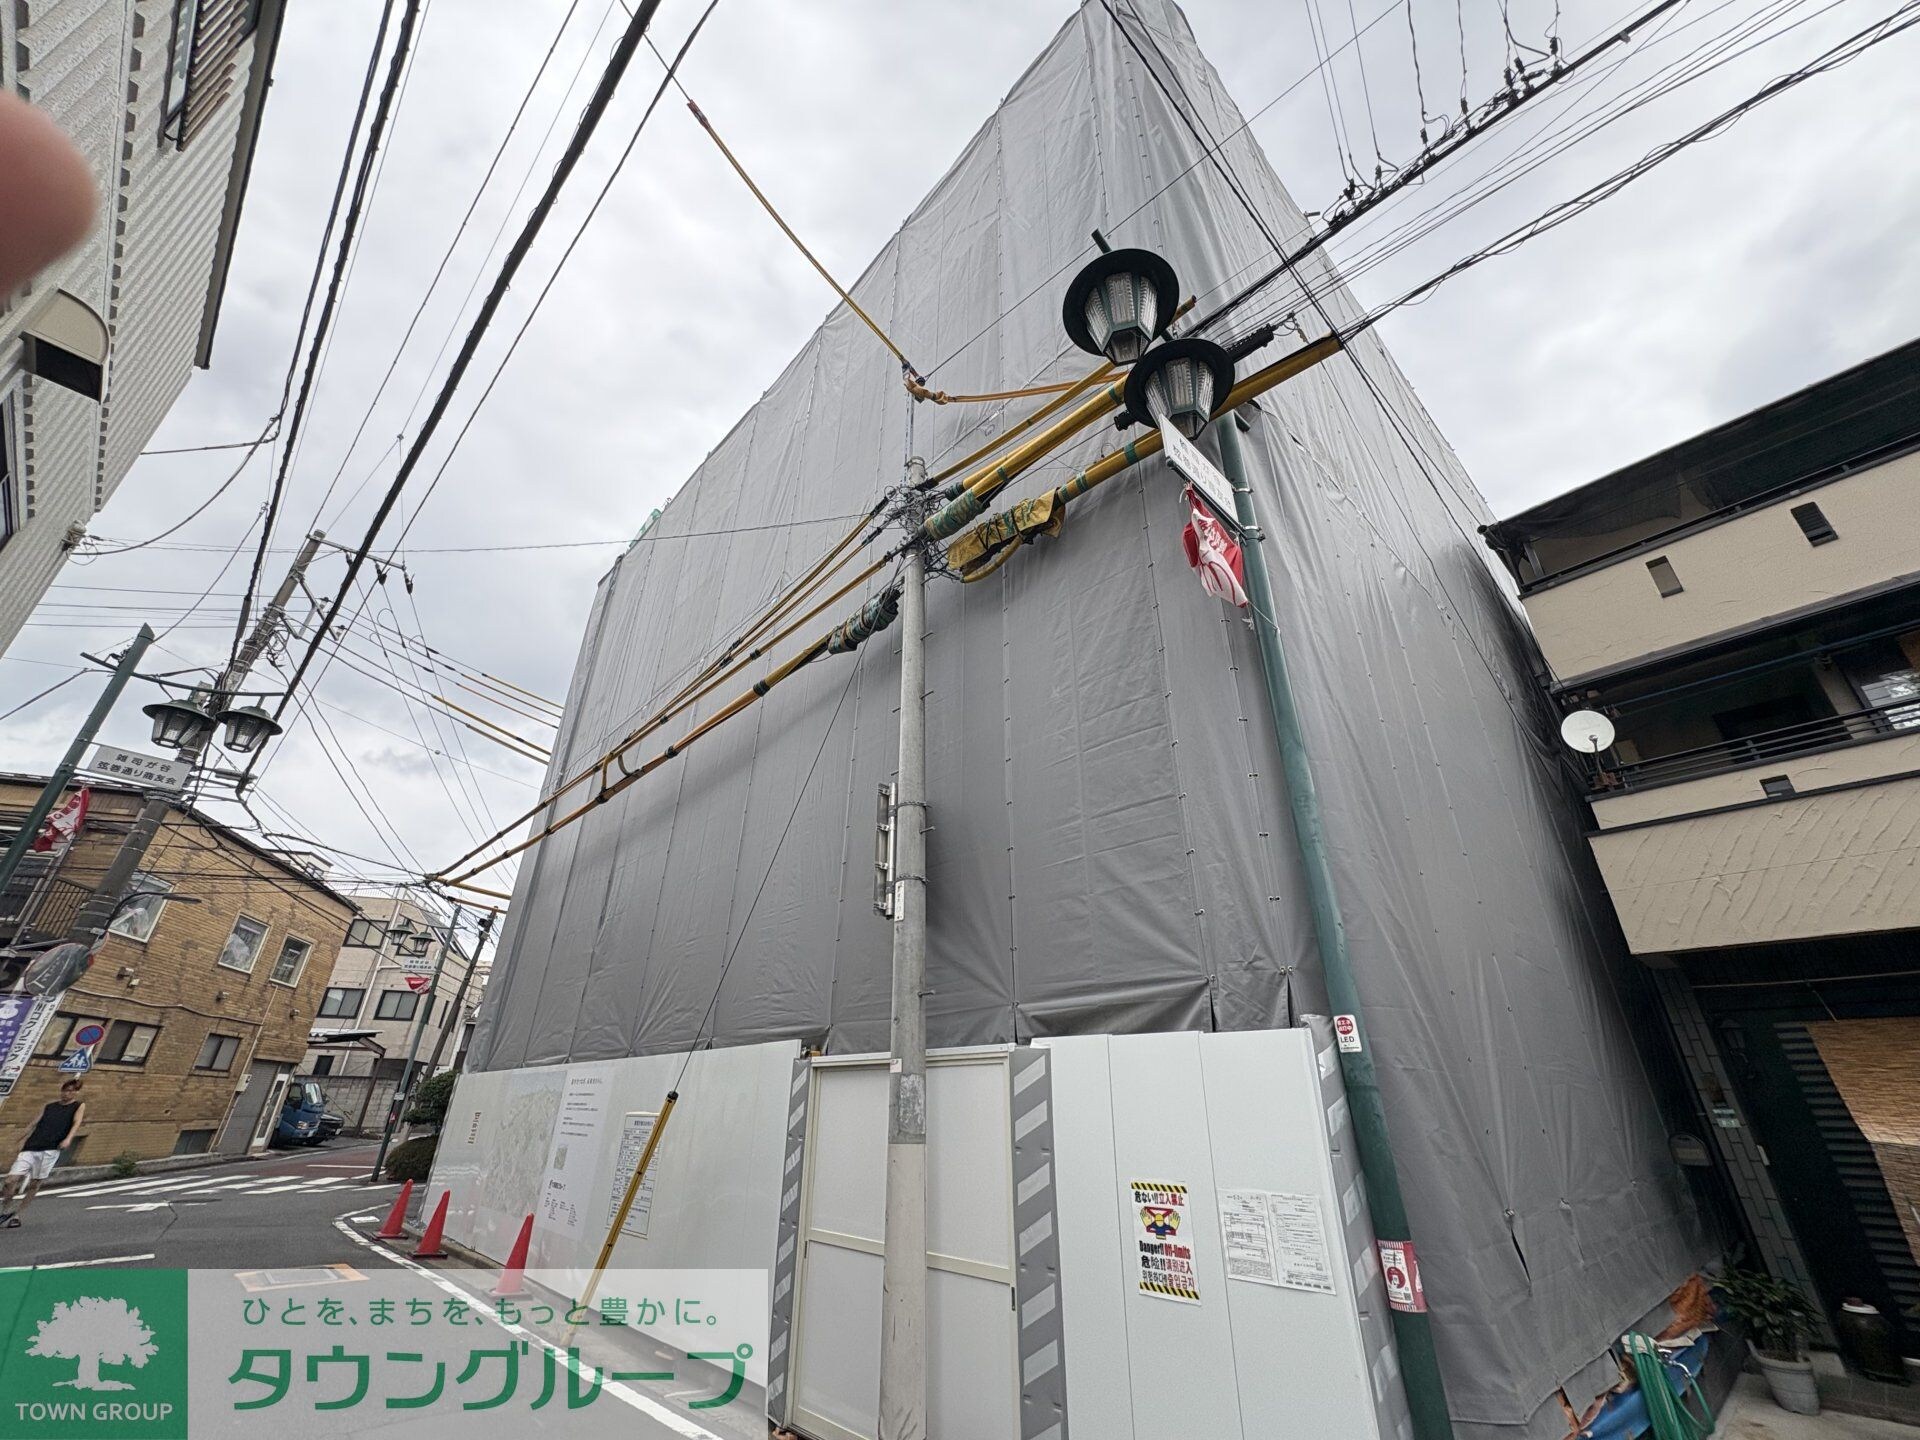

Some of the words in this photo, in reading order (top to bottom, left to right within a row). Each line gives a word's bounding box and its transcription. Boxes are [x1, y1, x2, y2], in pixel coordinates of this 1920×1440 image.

[96, 760, 178, 786] 弦巻通り商友会
[115, 753, 173, 773] 雑司が谷
